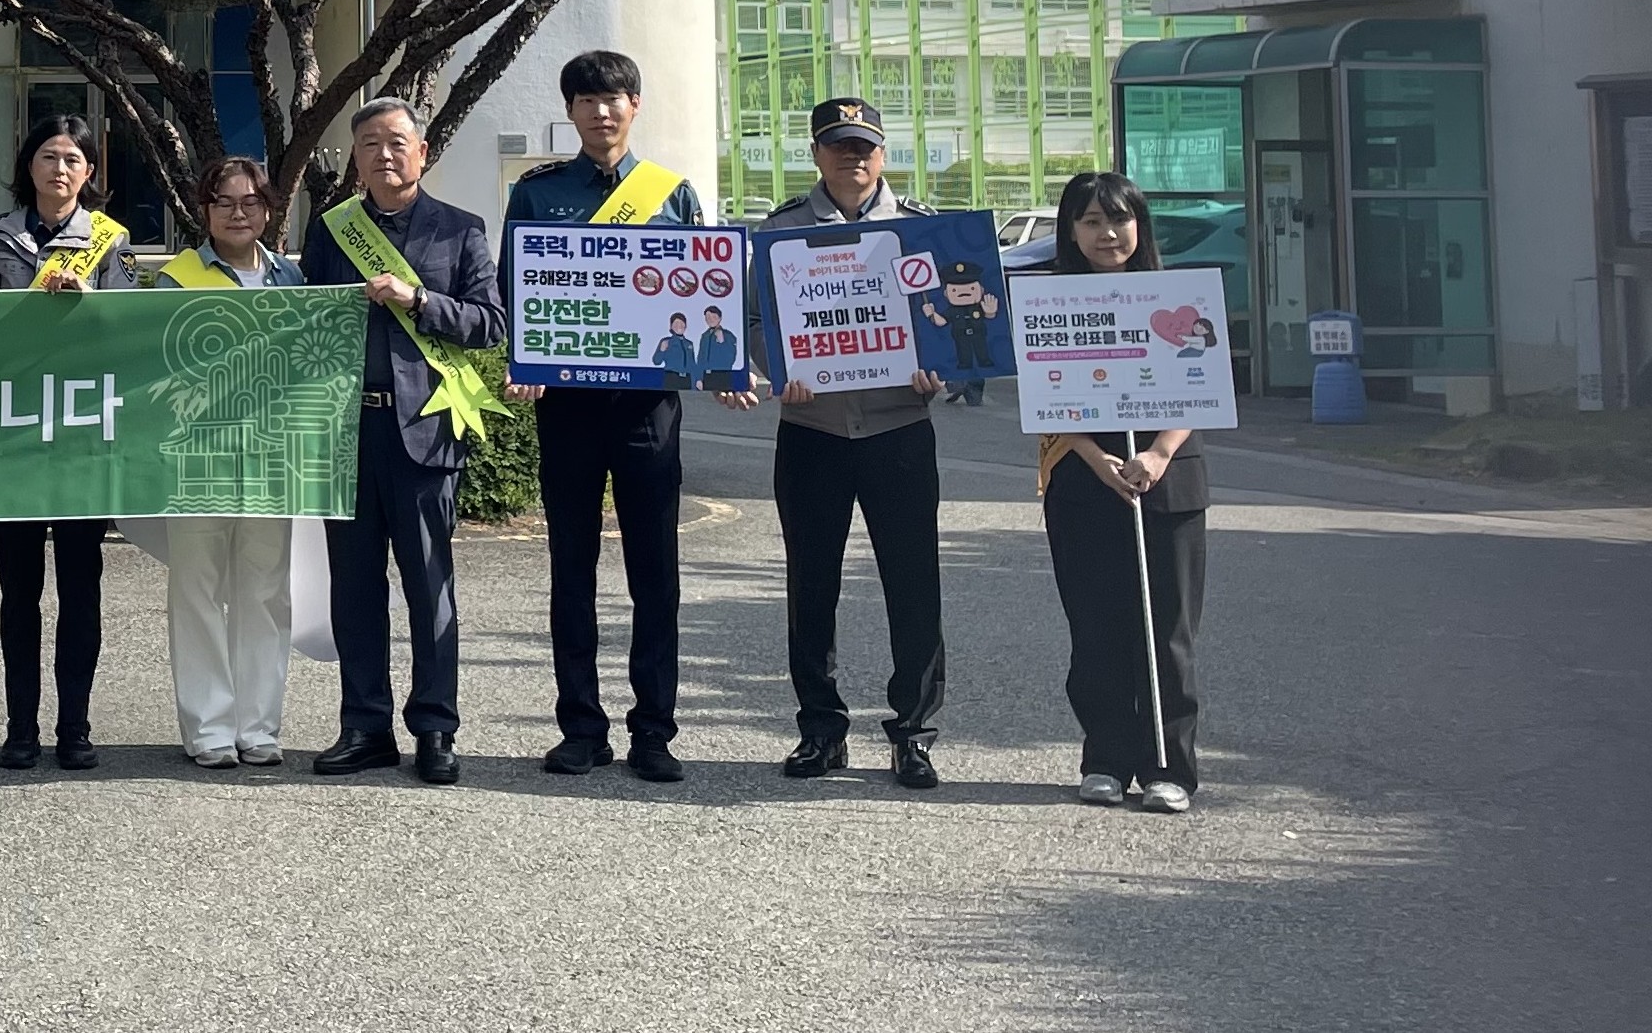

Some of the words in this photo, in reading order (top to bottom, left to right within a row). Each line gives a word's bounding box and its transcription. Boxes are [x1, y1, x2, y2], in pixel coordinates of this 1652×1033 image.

[522, 234, 575, 260] 폭력,
[580, 236, 633, 262] 마약,
[639, 237, 687, 261] 도박
[692, 236, 733, 263] NO
[522, 268, 589, 287] 유해환경
[592, 270, 626, 288] 없는
[798, 279, 847, 302] 사이버
[850, 276, 884, 297] 도박
[523, 297, 612, 326] 안전한
[802, 308, 851, 329] 게임이
[854, 305, 888, 325] 아닌
[1024, 313, 1068, 330] 당신의
[1071, 312, 1116, 328] 마음에
[523, 329, 642, 359] 학교생활
[789, 325, 909, 360] 범죄입니다
[1025, 332, 1070, 348] 따뜻한
[1073, 330, 1117, 347] 쉼표를
[1120, 329, 1151, 345] 찍다
[575, 369, 631, 383] 담양경찰서
[834, 366, 890, 383] 담양경찰서
[1036, 409, 1065, 421] 청소년
